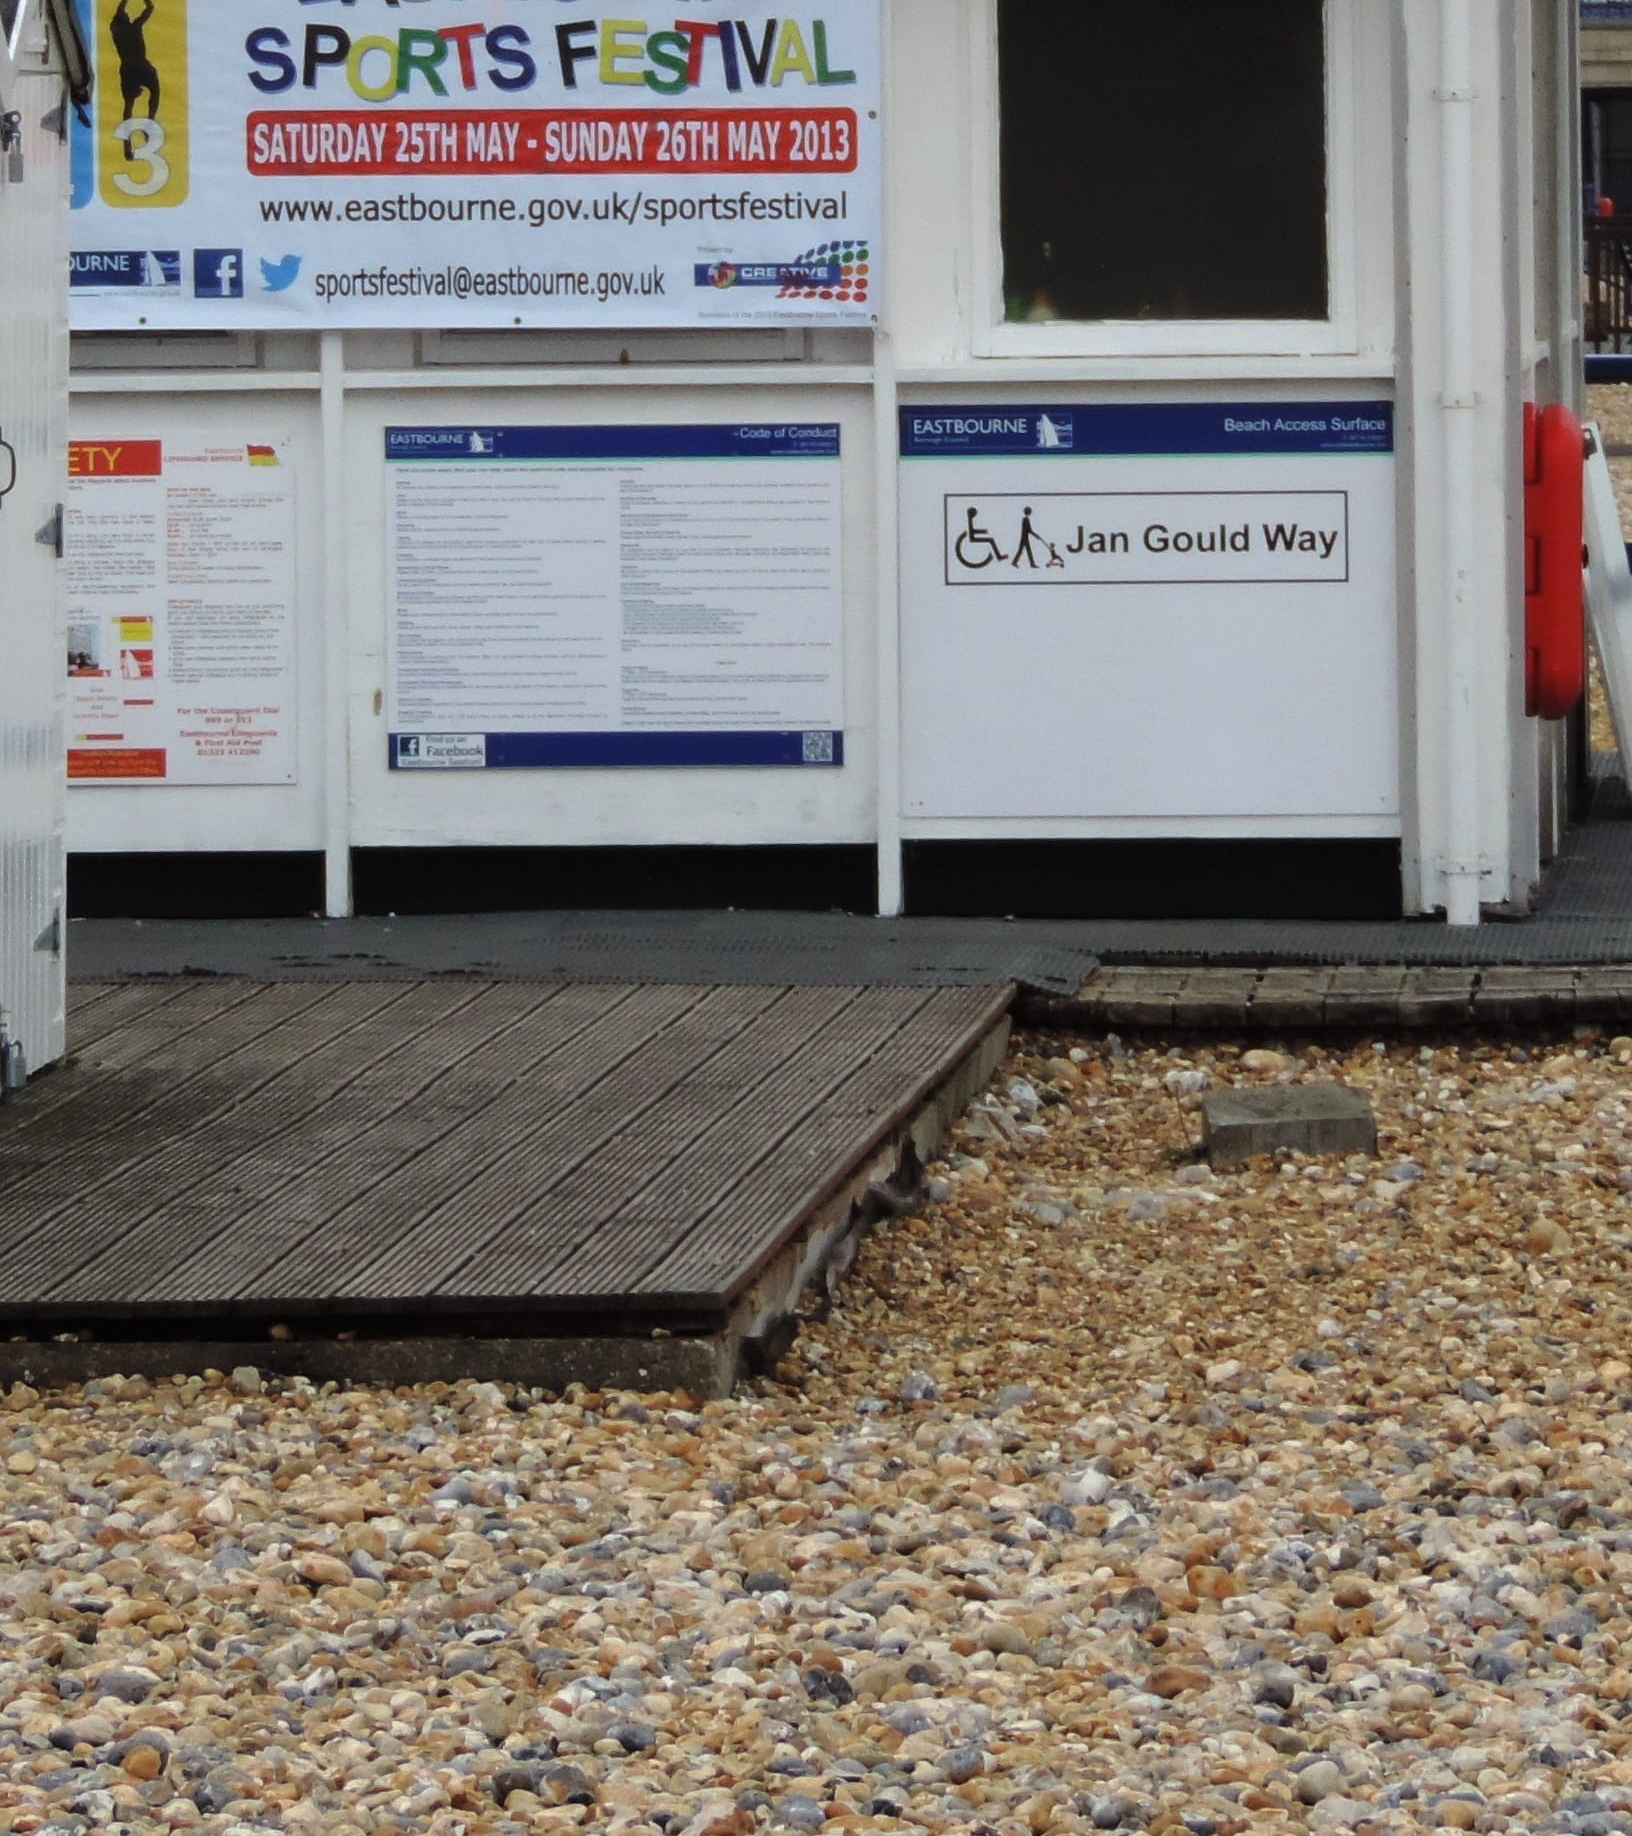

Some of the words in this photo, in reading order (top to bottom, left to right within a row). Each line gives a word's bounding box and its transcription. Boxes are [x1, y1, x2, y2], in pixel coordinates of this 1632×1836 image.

[245, 22, 538, 102] SPORTS
[555, 19, 857, 96] FESTIVAL
[253, 122, 388, 164] SATURDAY
[395, 121, 458, 163] 25TH
[466, 121, 520, 163] MAY
[544, 120, 648, 162] SUNDAY
[656, 120, 719, 162] 26TH
[728, 120, 781, 162] MAY
[789, 119, 850, 162] 2013
[259, 191, 848, 228] www.eastbourne.gov.uk/sportsfestival
[315, 264, 666, 303] sportsfestival@eastbourne.gov.uk
[739, 427, 771, 439] Code
[774, 427, 785, 438] of
[788, 426, 837, 439] Conduct
[913, 418, 1028, 435] EASTBOURNE
[1224, 418, 1270, 432] Beach
[1274, 418, 1327, 431] Access
[1330, 417, 1386, 431] Surface
[390, 433, 464, 445] EASTBOURNE
[69, 446, 123, 471] ETY
[1066, 524, 1129, 554] Jan
[1143, 523, 1250, 554] Gould
[1262, 523, 1338, 560] Way
[426, 744, 484, 757] Facebook
